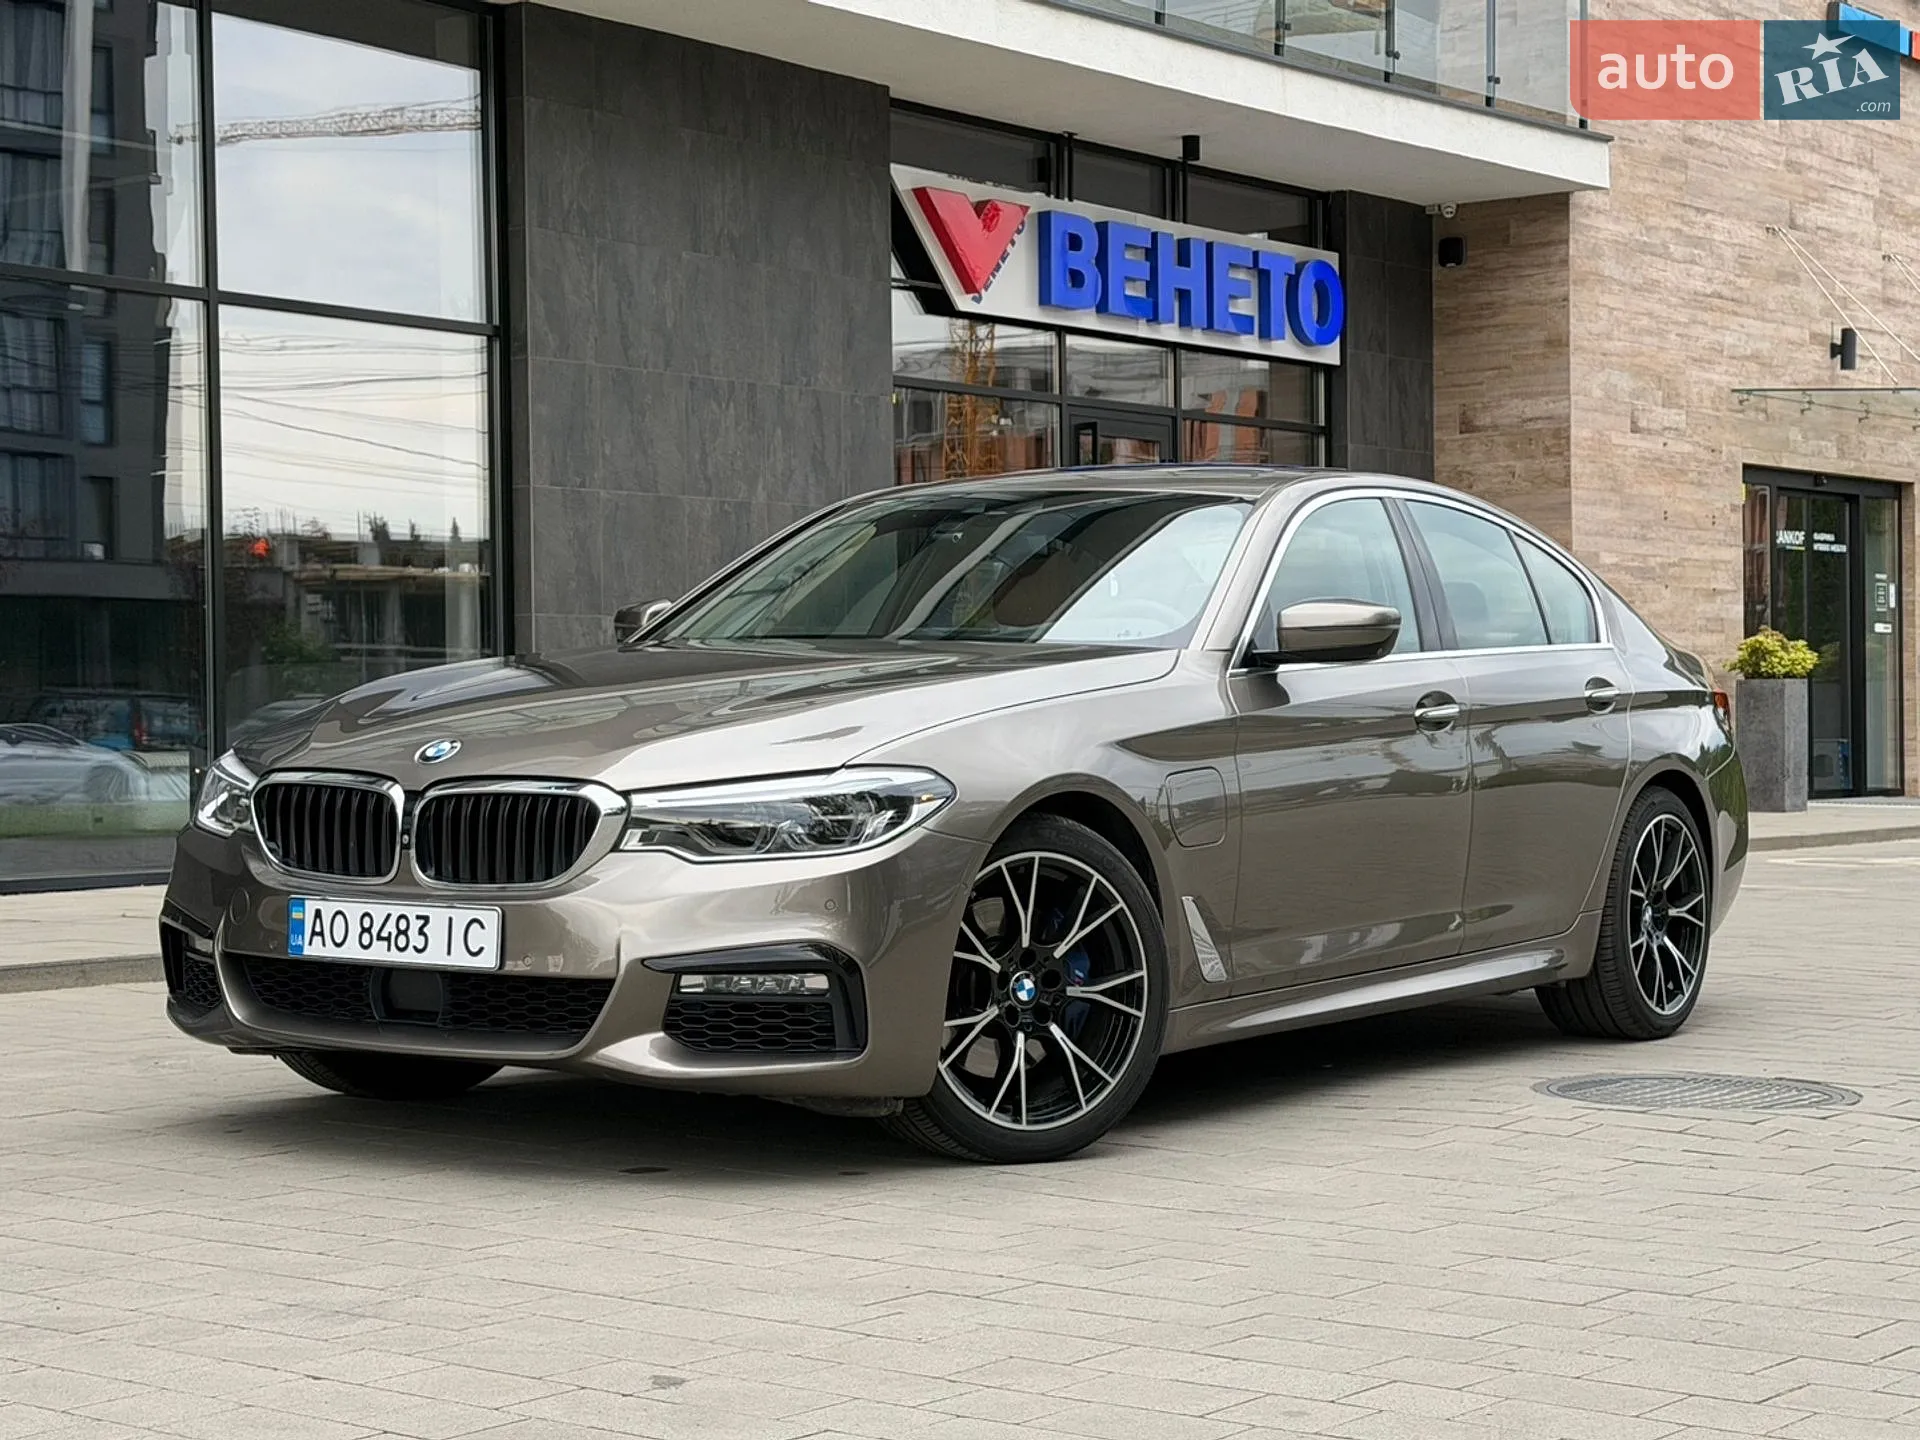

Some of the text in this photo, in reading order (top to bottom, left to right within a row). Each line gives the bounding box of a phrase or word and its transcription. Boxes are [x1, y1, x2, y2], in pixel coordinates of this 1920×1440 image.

[1038, 210, 1347, 347] ВЕНЕТО
[1776, 530, 1806, 545] ANKOF
[290, 934, 304, 946] UA
[308, 908, 486, 958] AO 8483 IC
